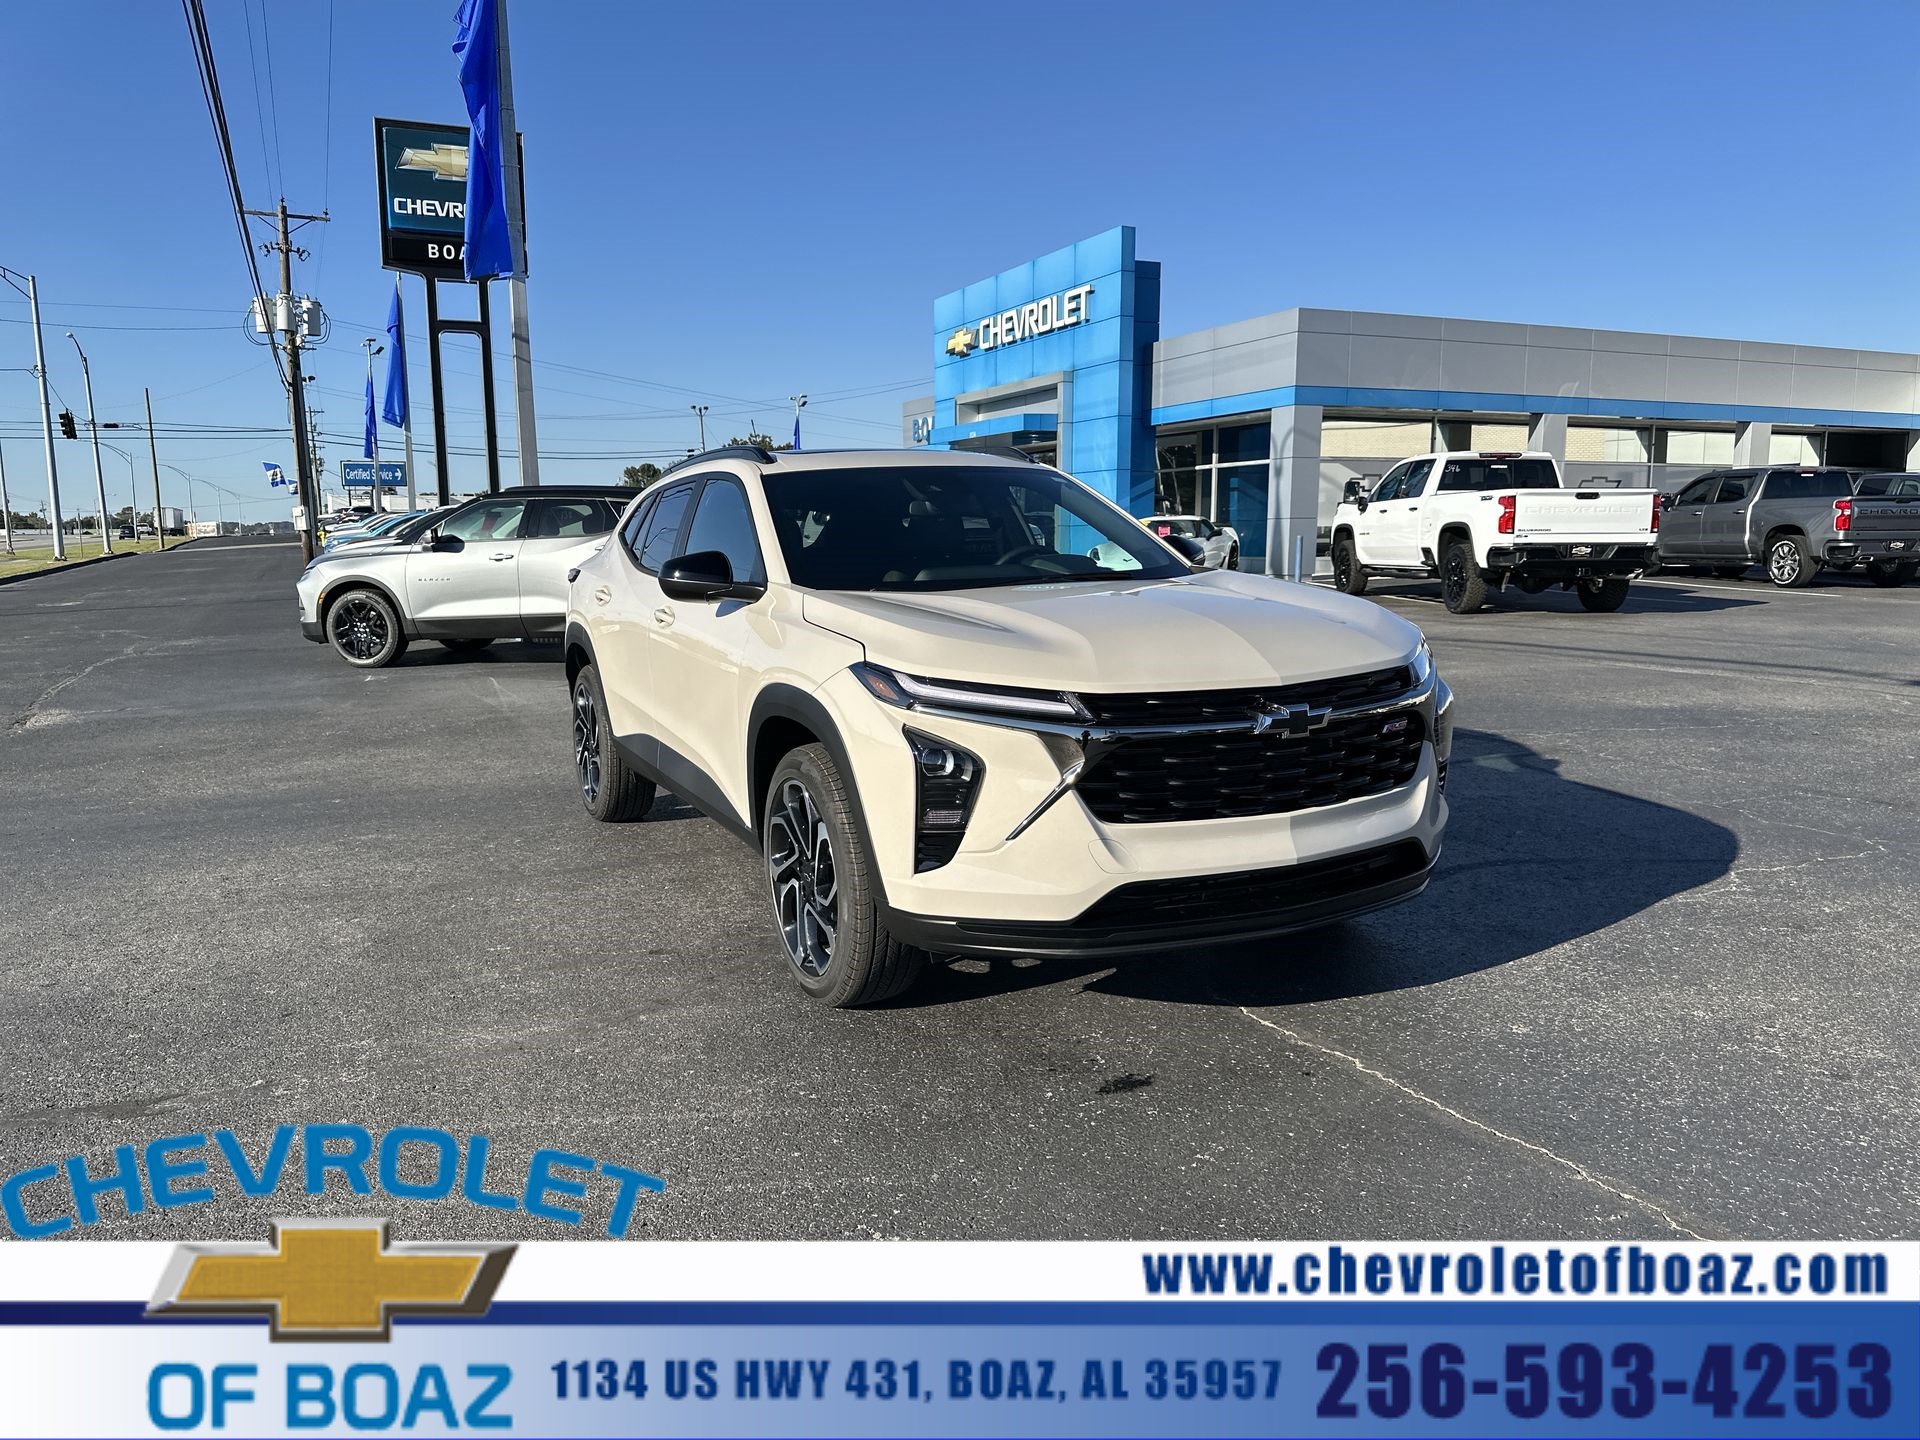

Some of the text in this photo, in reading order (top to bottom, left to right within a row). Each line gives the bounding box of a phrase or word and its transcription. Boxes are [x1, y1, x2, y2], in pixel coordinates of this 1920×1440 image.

[393, 197, 467, 219] CHEVR
[978, 284, 1094, 351] CHEVROLET
[912, 416, 935, 442] BO
[345, 468, 393, 480] Certified Srvice
